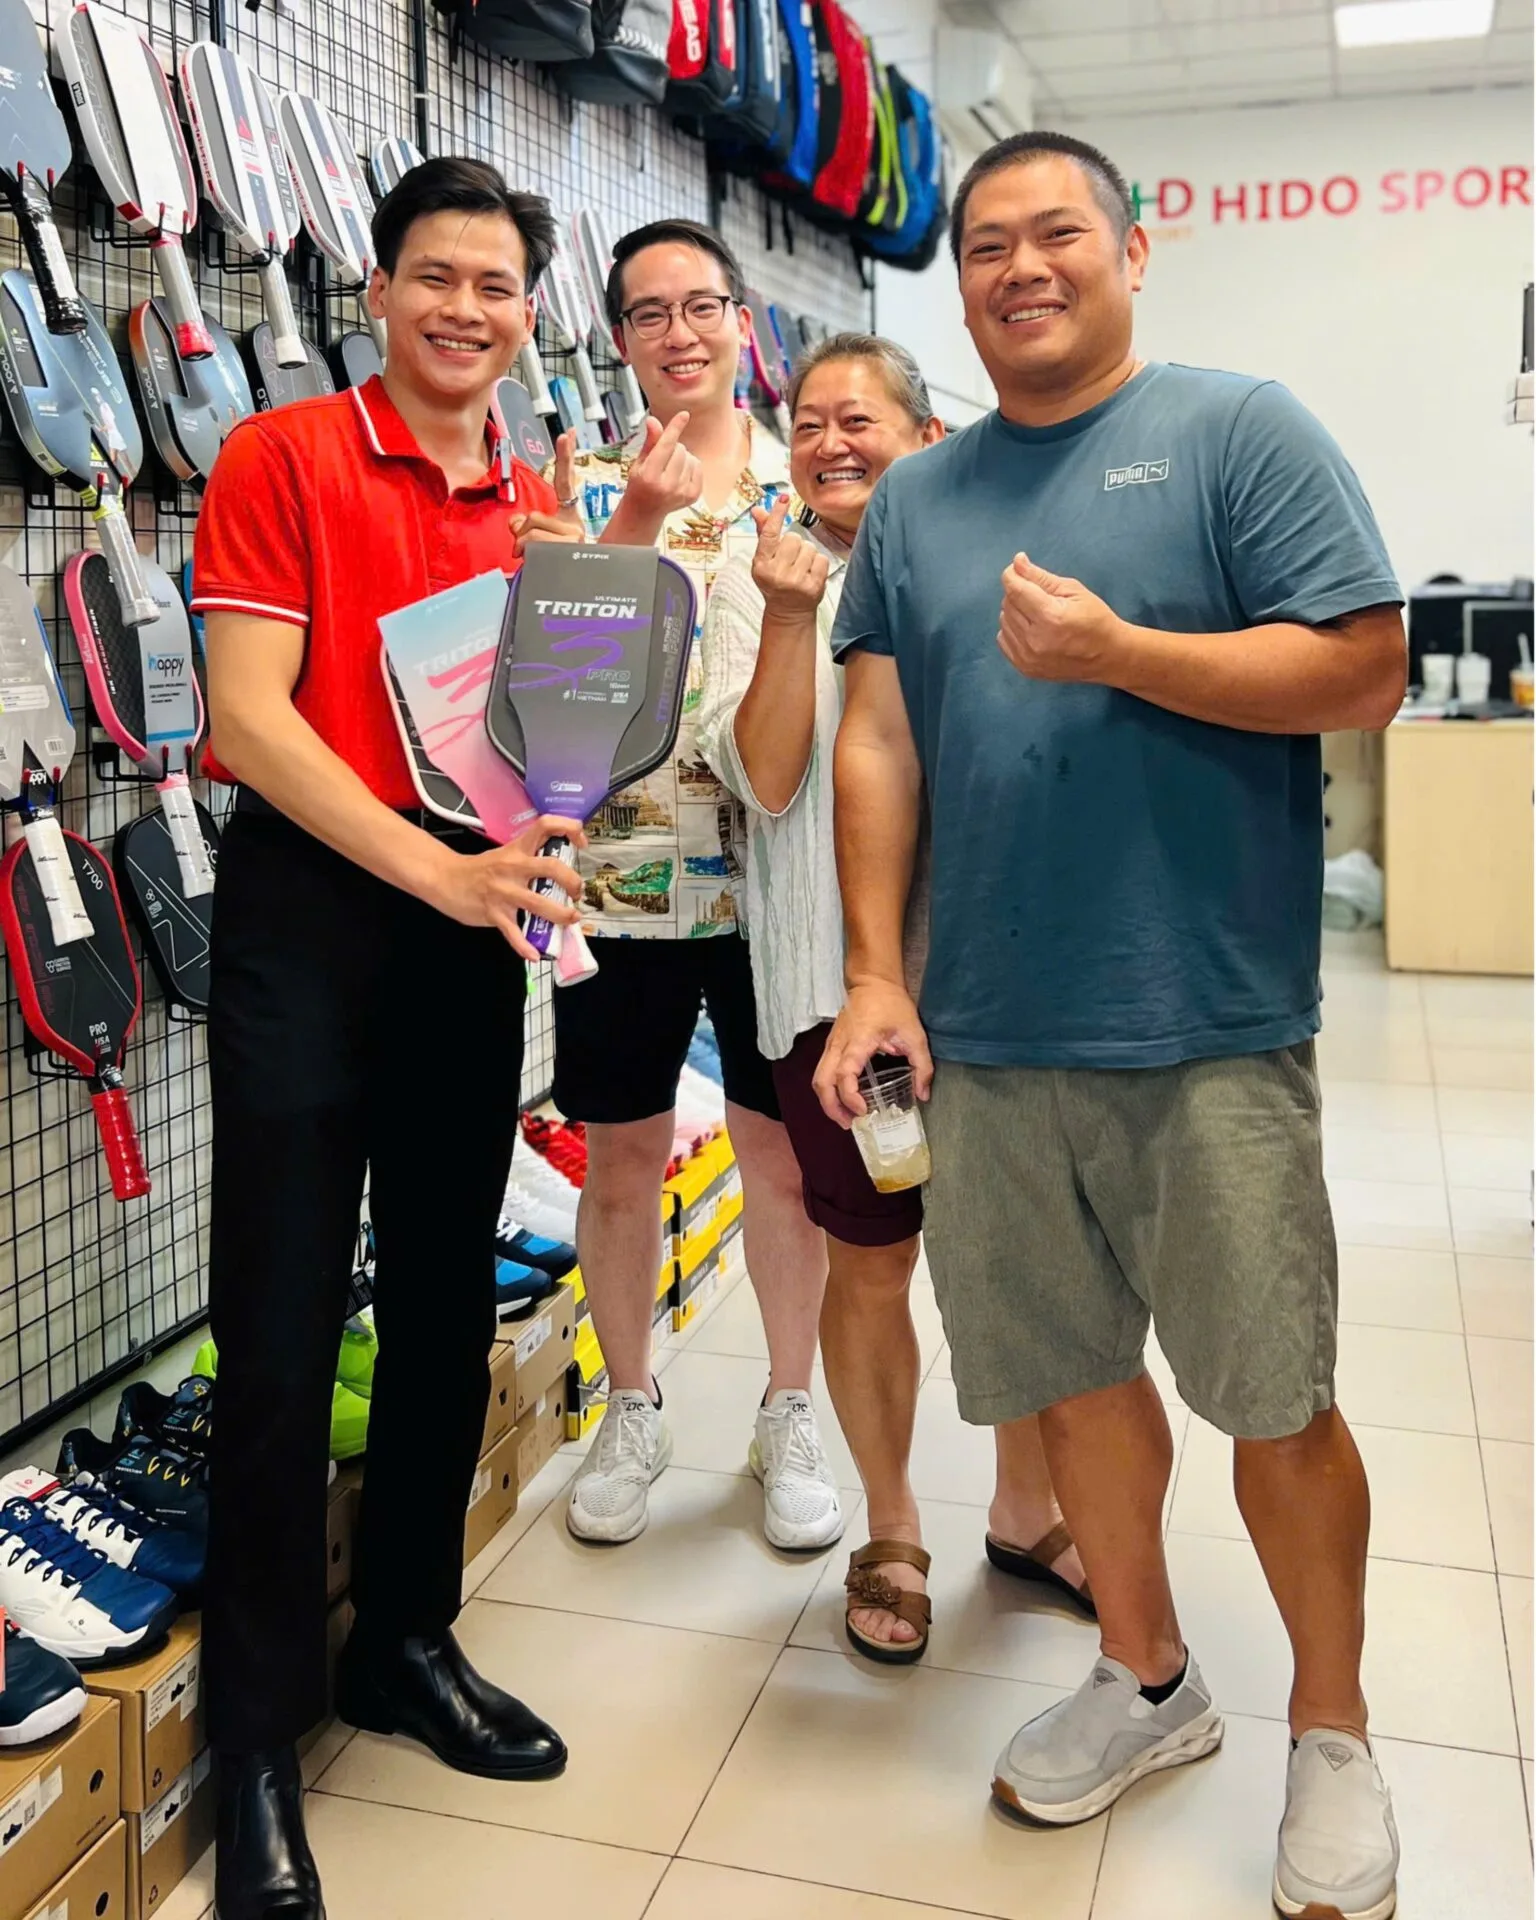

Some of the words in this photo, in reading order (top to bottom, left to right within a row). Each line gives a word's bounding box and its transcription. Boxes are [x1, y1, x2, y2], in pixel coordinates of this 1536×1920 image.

[1213, 175, 1360, 223] HIDO
[1109, 466, 1143, 486] PUMA
[534, 600, 637, 619] TRITON
[594, 596, 638, 604] ULTIMATE
[148, 652, 185, 677] happy
[586, 668, 631, 682] PRO
[82, 859, 104, 890] T700
[89, 1021, 108, 1036] PRO
